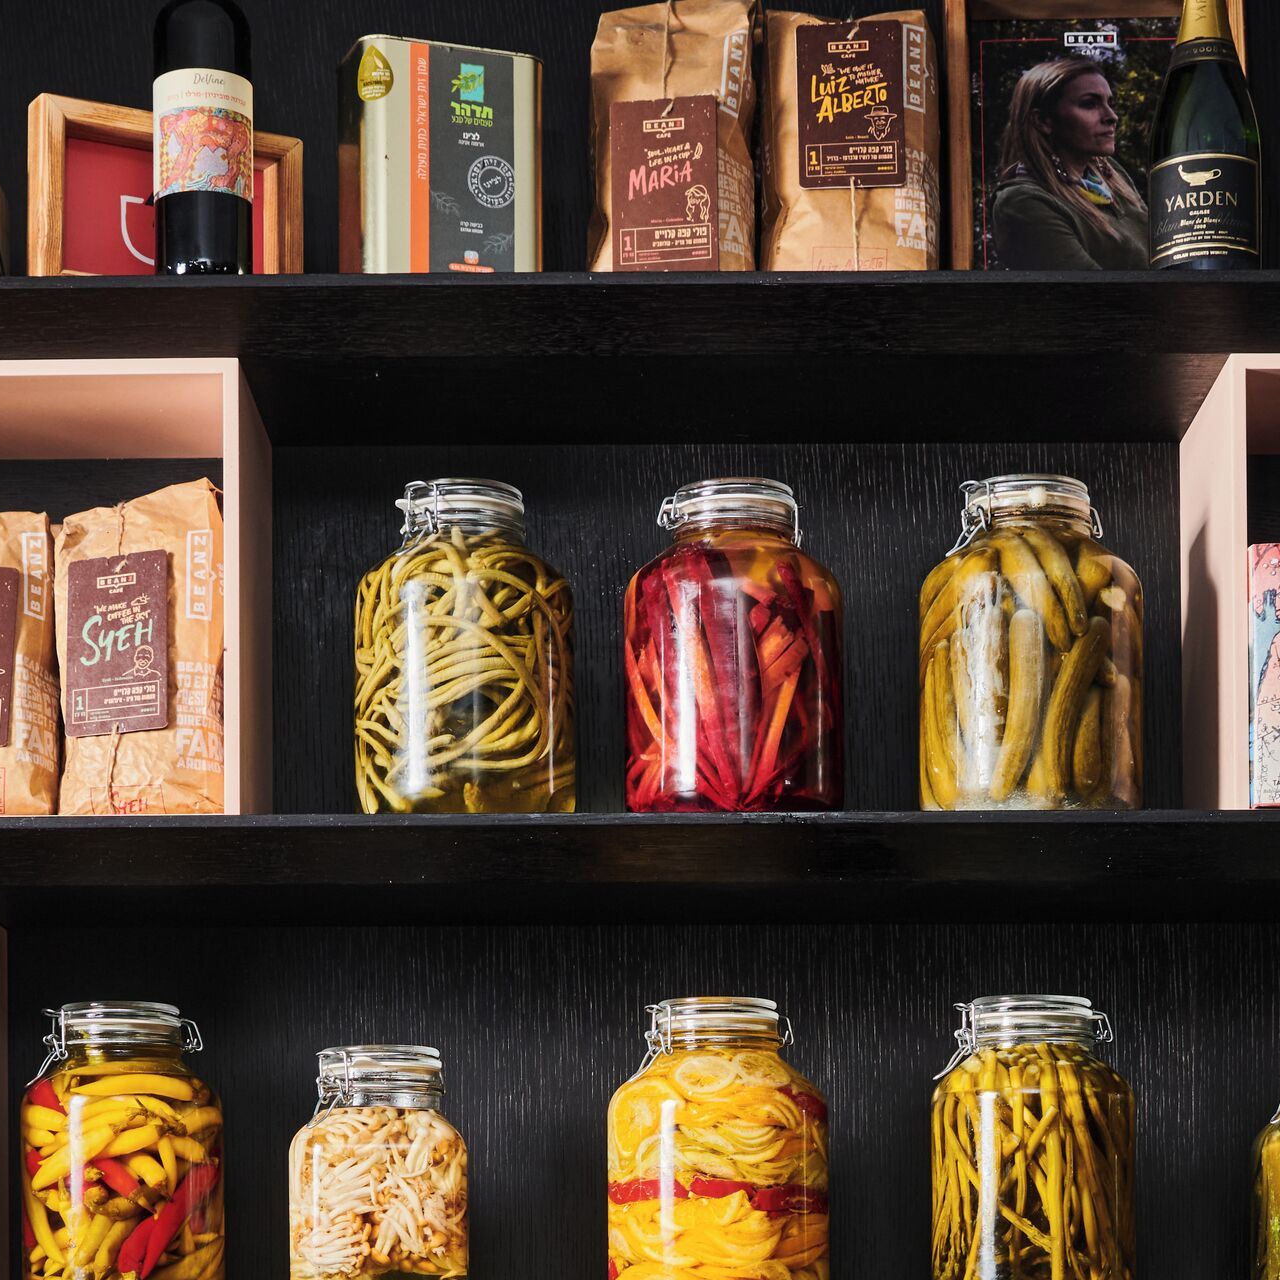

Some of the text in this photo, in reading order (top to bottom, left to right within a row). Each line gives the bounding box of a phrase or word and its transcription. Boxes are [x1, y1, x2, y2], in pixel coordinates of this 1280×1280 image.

[417, 57, 428, 76] שמן
[910, 31, 921, 104] BEANZ
[418, 76, 427, 92] זית
[416, 94, 426, 124] ישראלי
[450, 101, 493, 119] תדהר
[816, 82, 888, 124] ALBERTO
[418, 128, 426, 149] כתית
[1165, 191, 1238, 213] YARDEN
[30, 538, 42, 612] BEANZ
[100, 575, 133, 586] BEANZ
[193, 535, 208, 612] BEANZ
